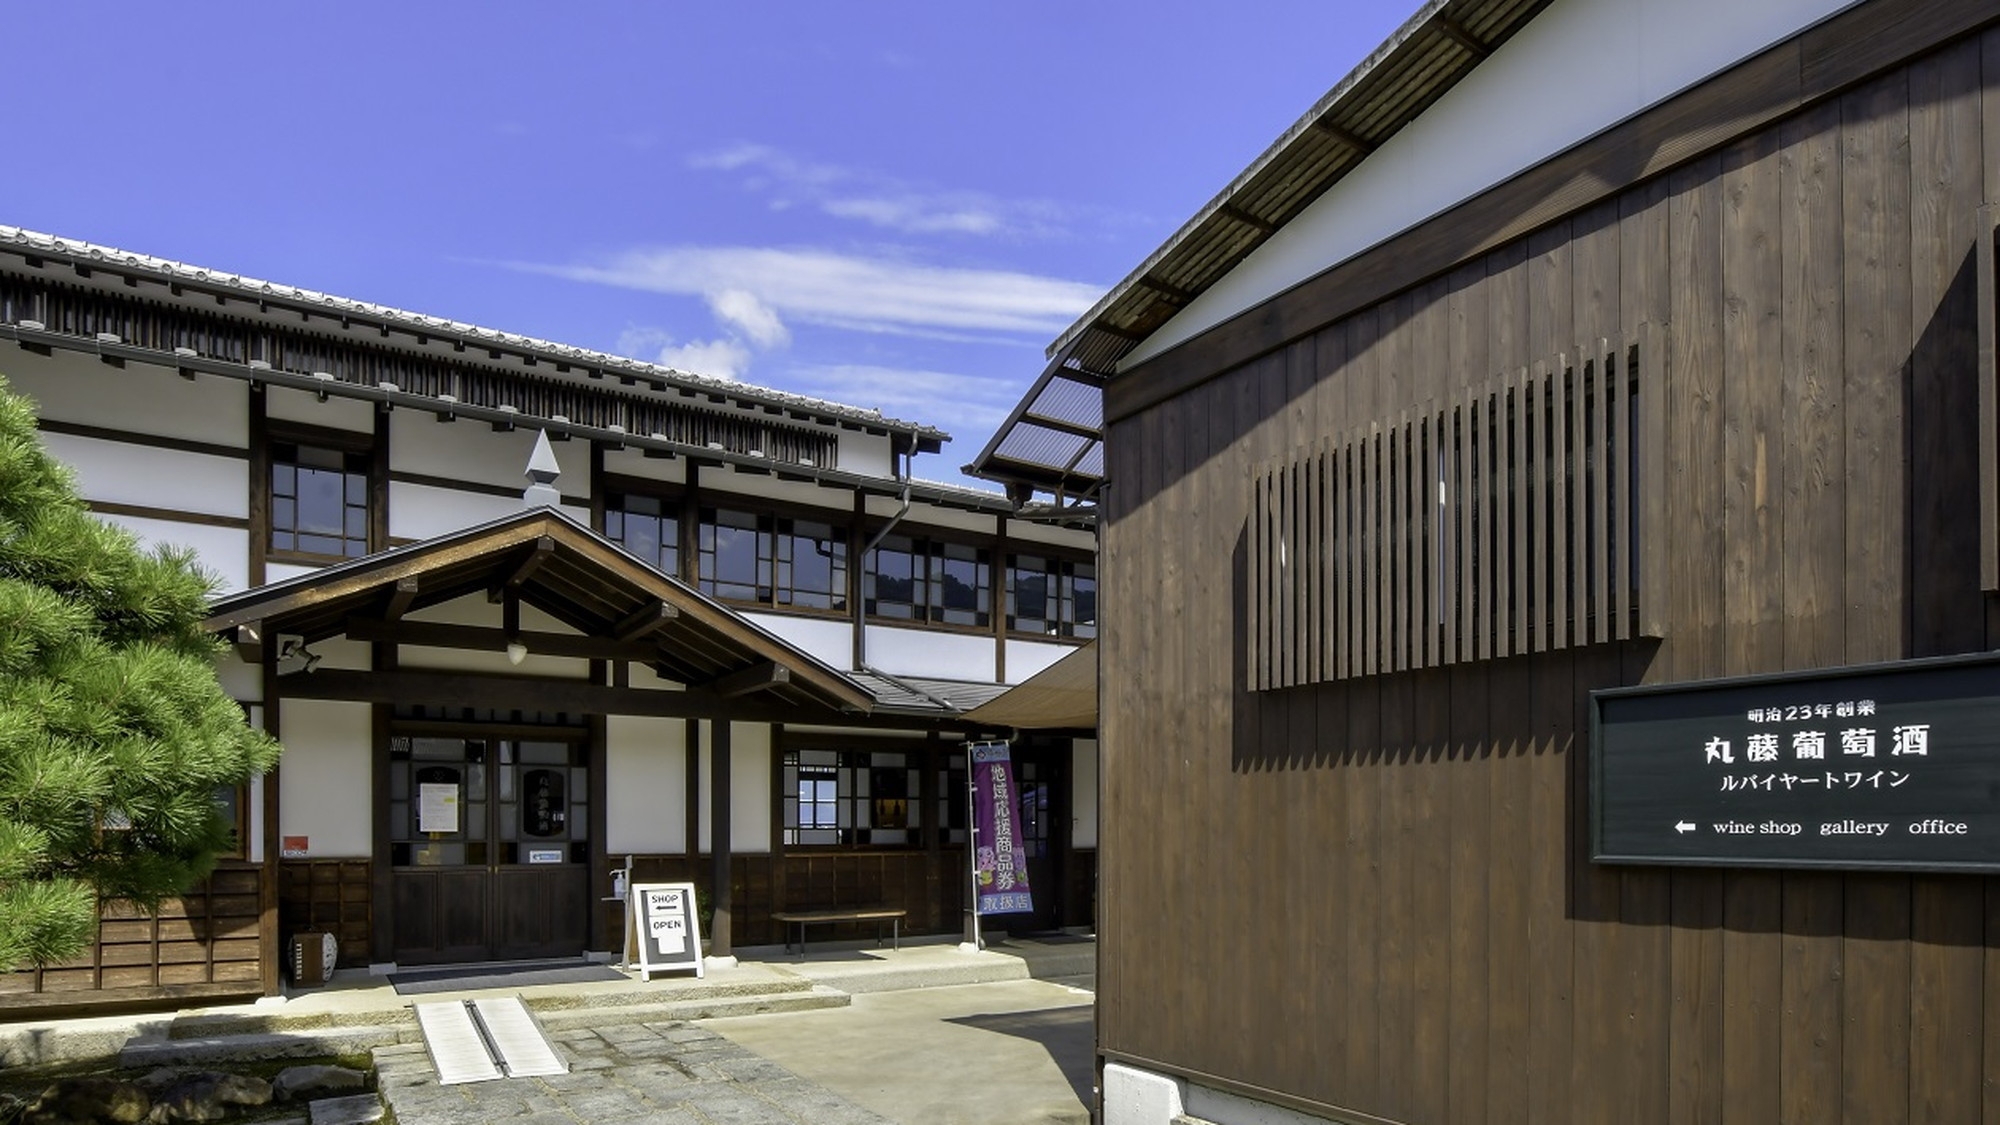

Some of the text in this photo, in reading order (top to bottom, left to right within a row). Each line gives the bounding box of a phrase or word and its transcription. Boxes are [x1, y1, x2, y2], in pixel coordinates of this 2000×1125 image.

[1747, 700, 1876, 723] 明治23年創業
[1704, 724, 1930, 764] 丸藤葡萄酒
[1720, 770, 1910, 792] ルバイヤートワイン
[1714, 820, 1968, 836] wine shop gallery office
[651, 894, 679, 903] SHOP
[983, 895, 1028, 912] 取扱店
[653, 920, 682, 930] OPEN
